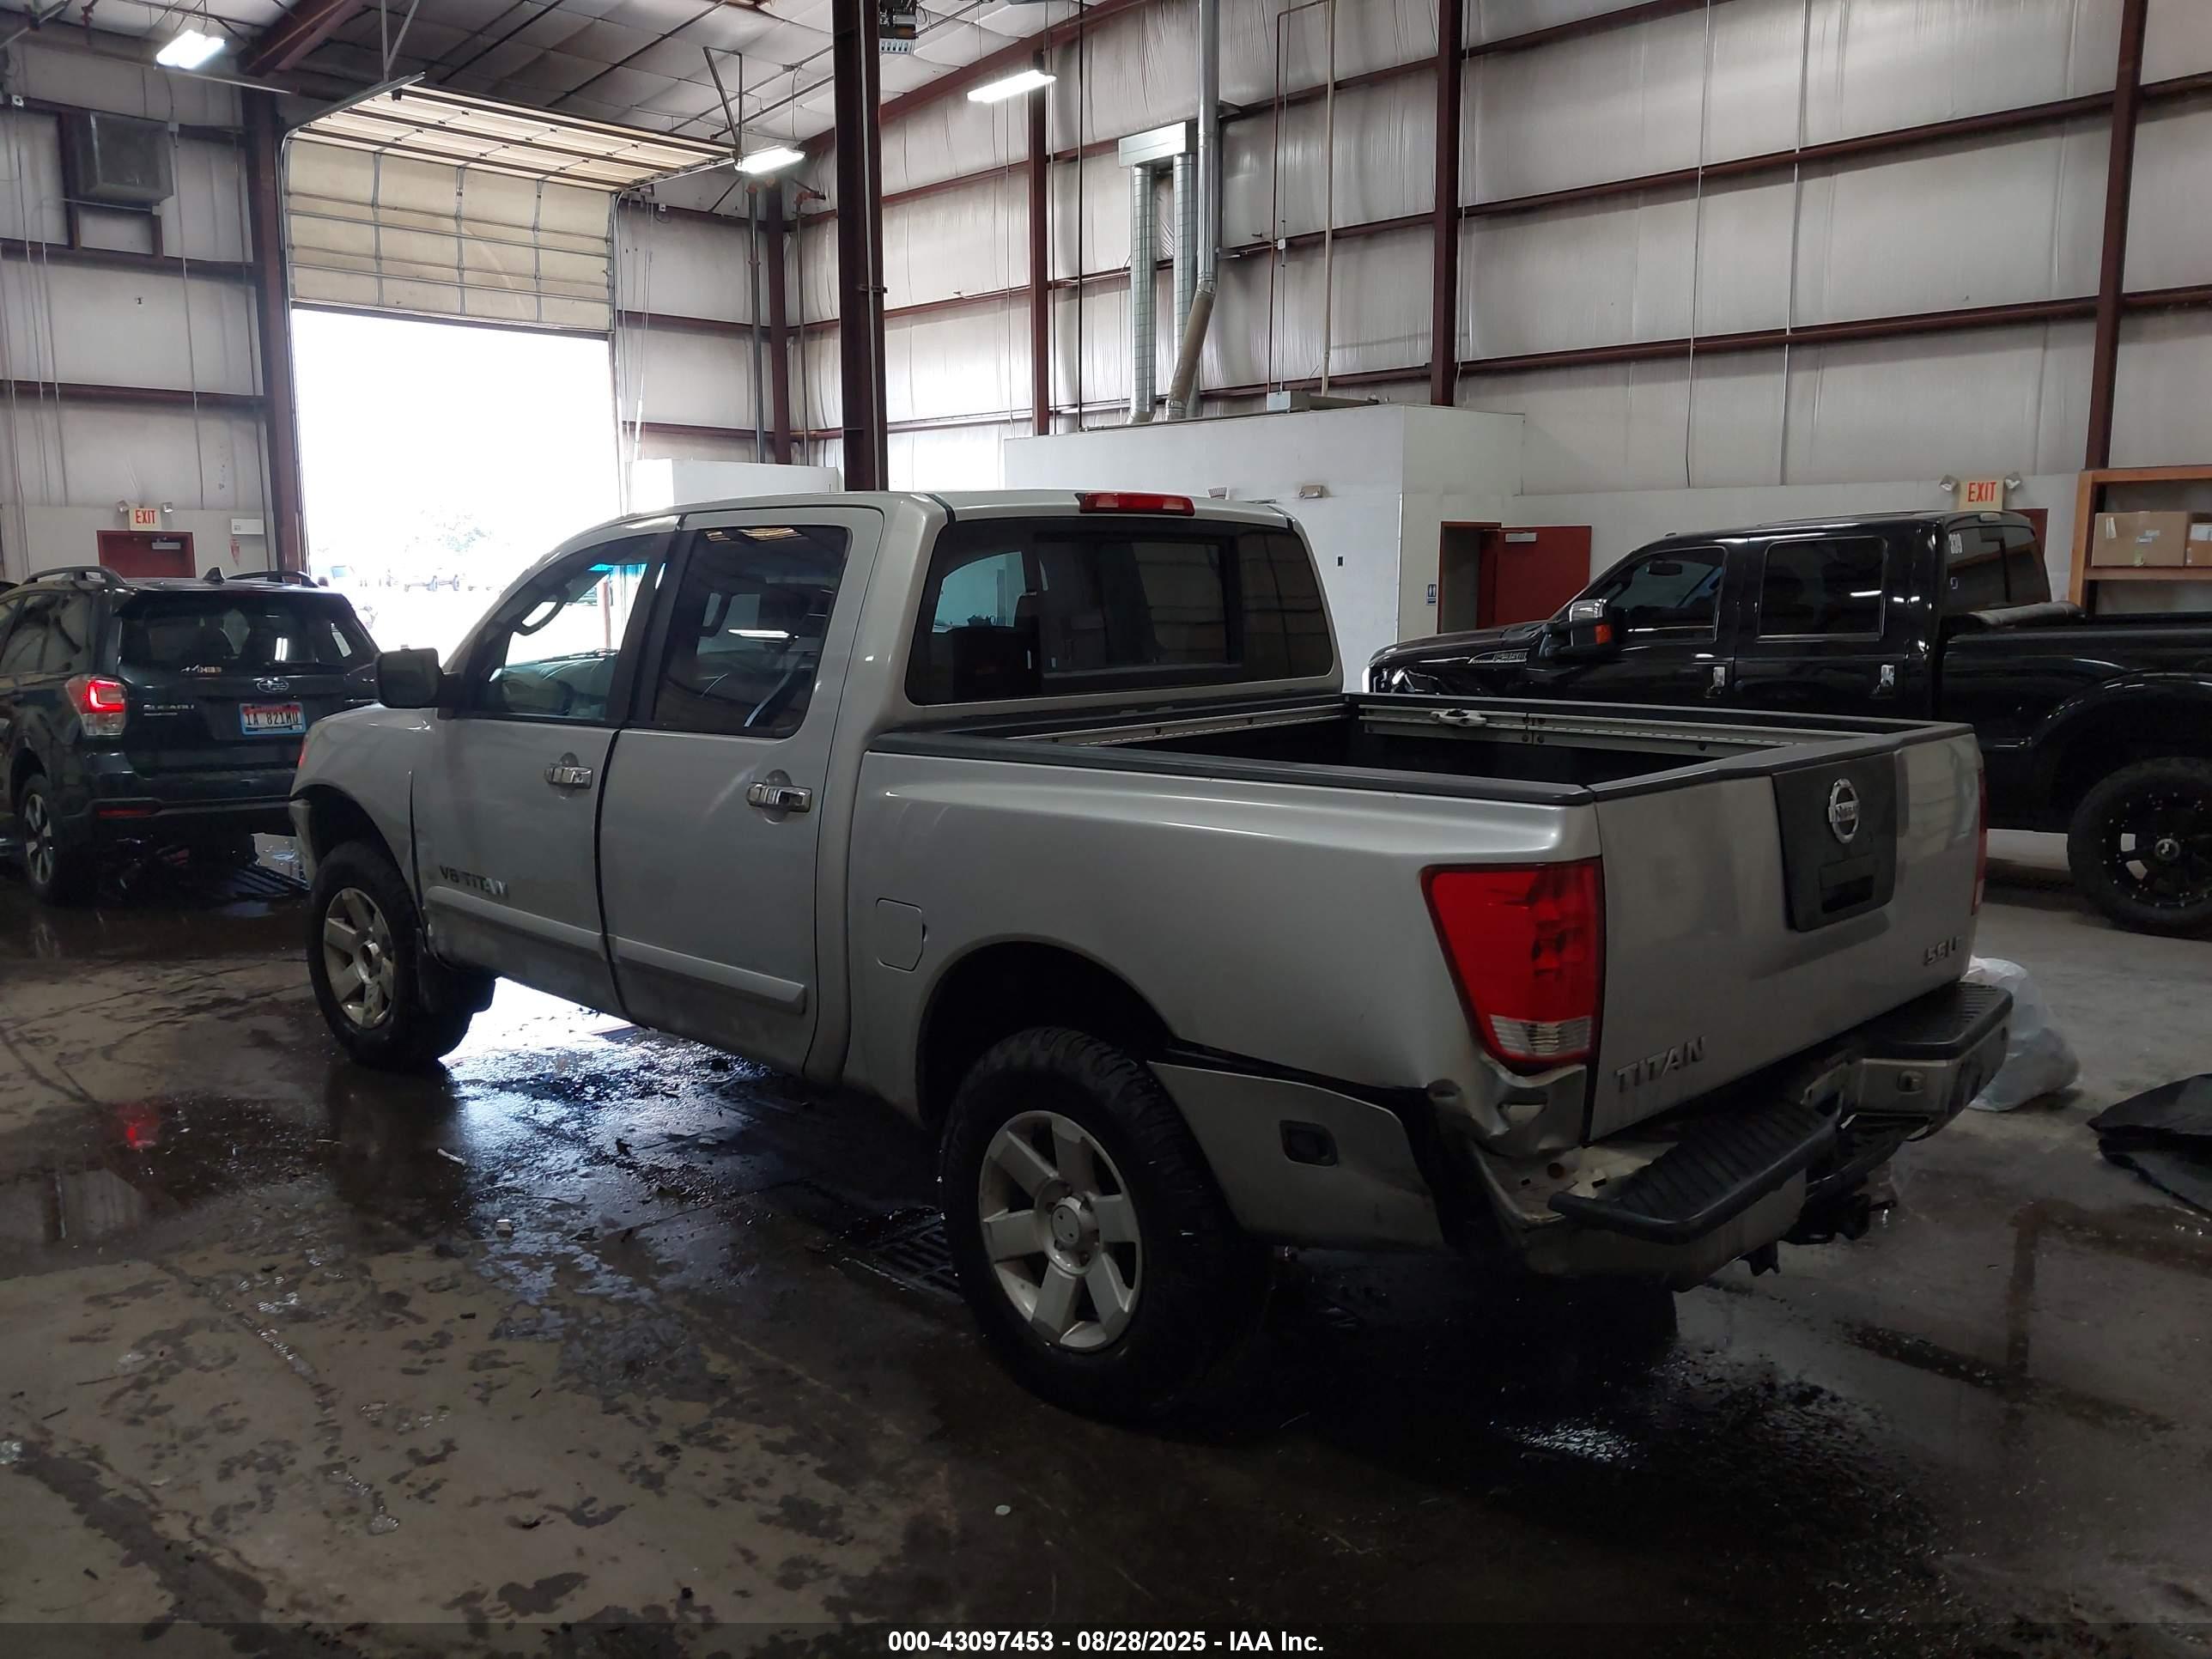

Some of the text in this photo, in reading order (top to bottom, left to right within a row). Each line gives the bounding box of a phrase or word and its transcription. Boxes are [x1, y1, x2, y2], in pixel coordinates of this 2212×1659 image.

[1967, 481, 1996, 502] EXIT
[135, 509, 156, 524] EXIT
[460, 871, 509, 898] TITAN
[1614, 1036, 1706, 1093] TITAN
